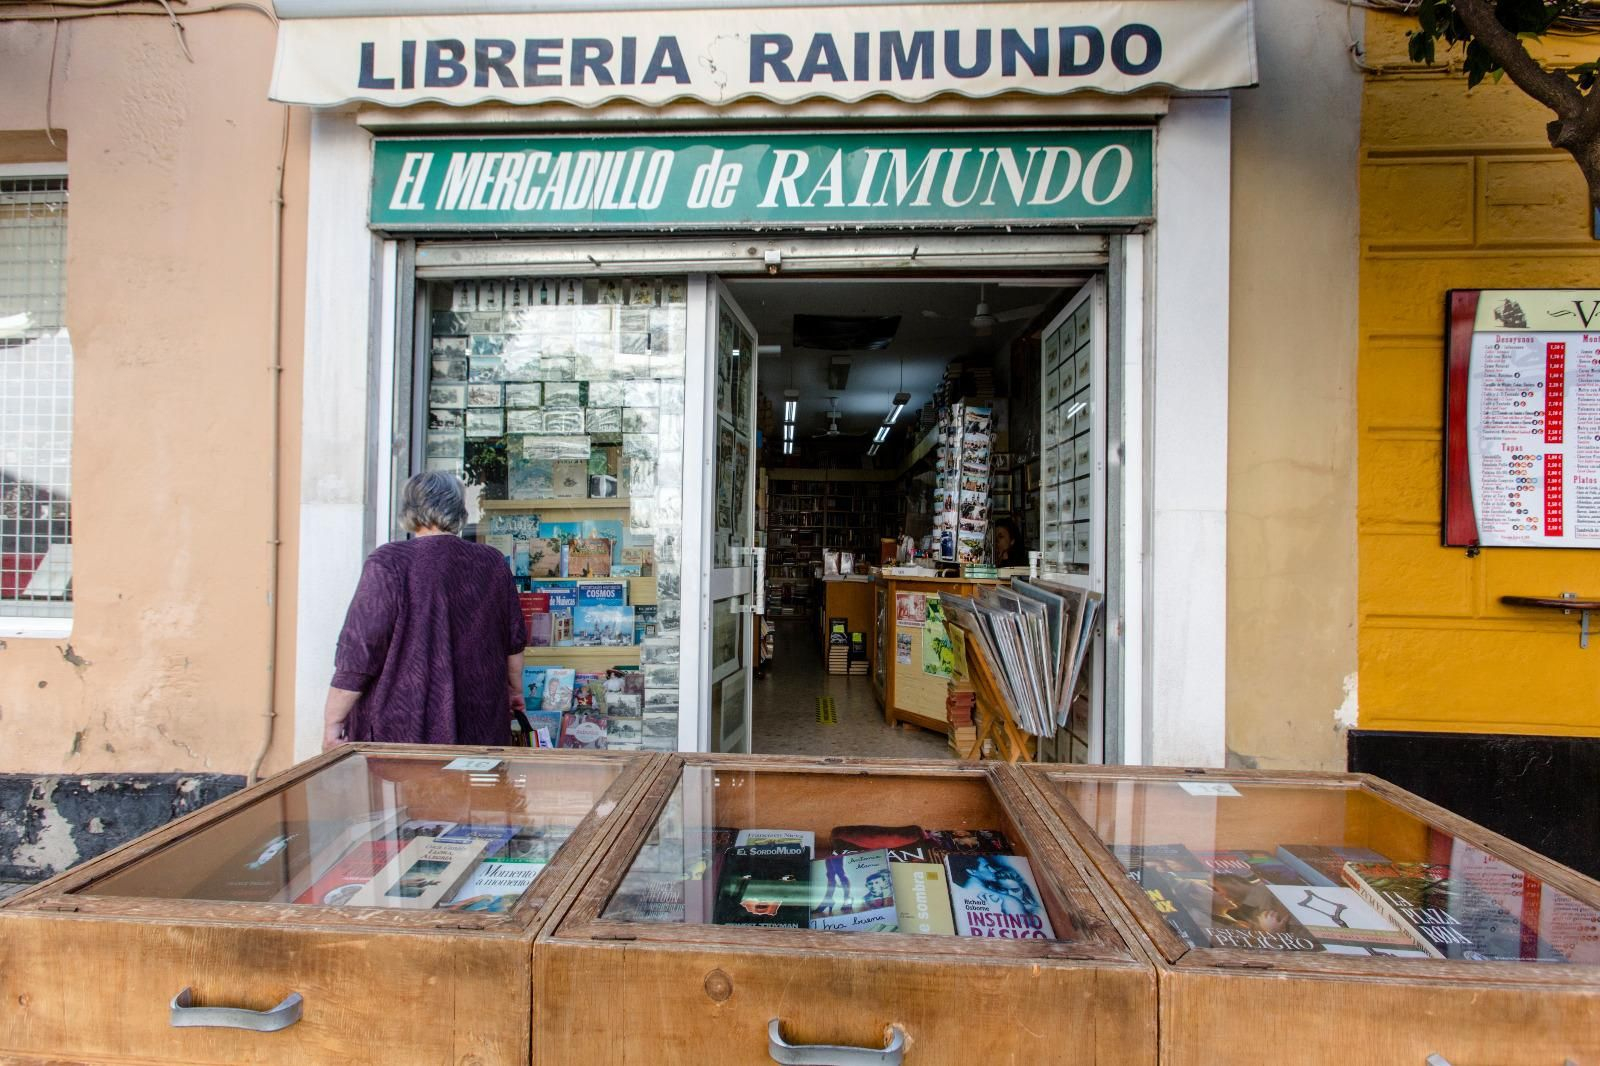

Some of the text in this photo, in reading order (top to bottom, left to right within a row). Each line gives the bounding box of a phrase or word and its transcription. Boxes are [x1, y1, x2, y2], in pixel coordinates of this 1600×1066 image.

[357, 23, 1163, 90] LIBRERIA RAIMUNDO
[389, 144, 1134, 211] EL MERCADILLO de RAIMUNDO
[1496, 335, 1535, 344] Desayunos
[1501, 443, 1523, 453] Tapas
[1573, 475, 1598, 484] Platos
[586, 590, 616, 598] COSMOS
[480, 864, 537, 878] Momento
[912, 871, 929, 920] sombra
[964, 898, 986, 906] Richard
[1382, 891, 1414, 907] LA
[967, 912, 1043, 930] INSTINTO
[1400, 908, 1462, 925] PLAZA
[1205, 927, 1277, 942] ESENCIA
[1418, 925, 1473, 944] ROJA
[1215, 935, 1314, 950] PELIGRO
